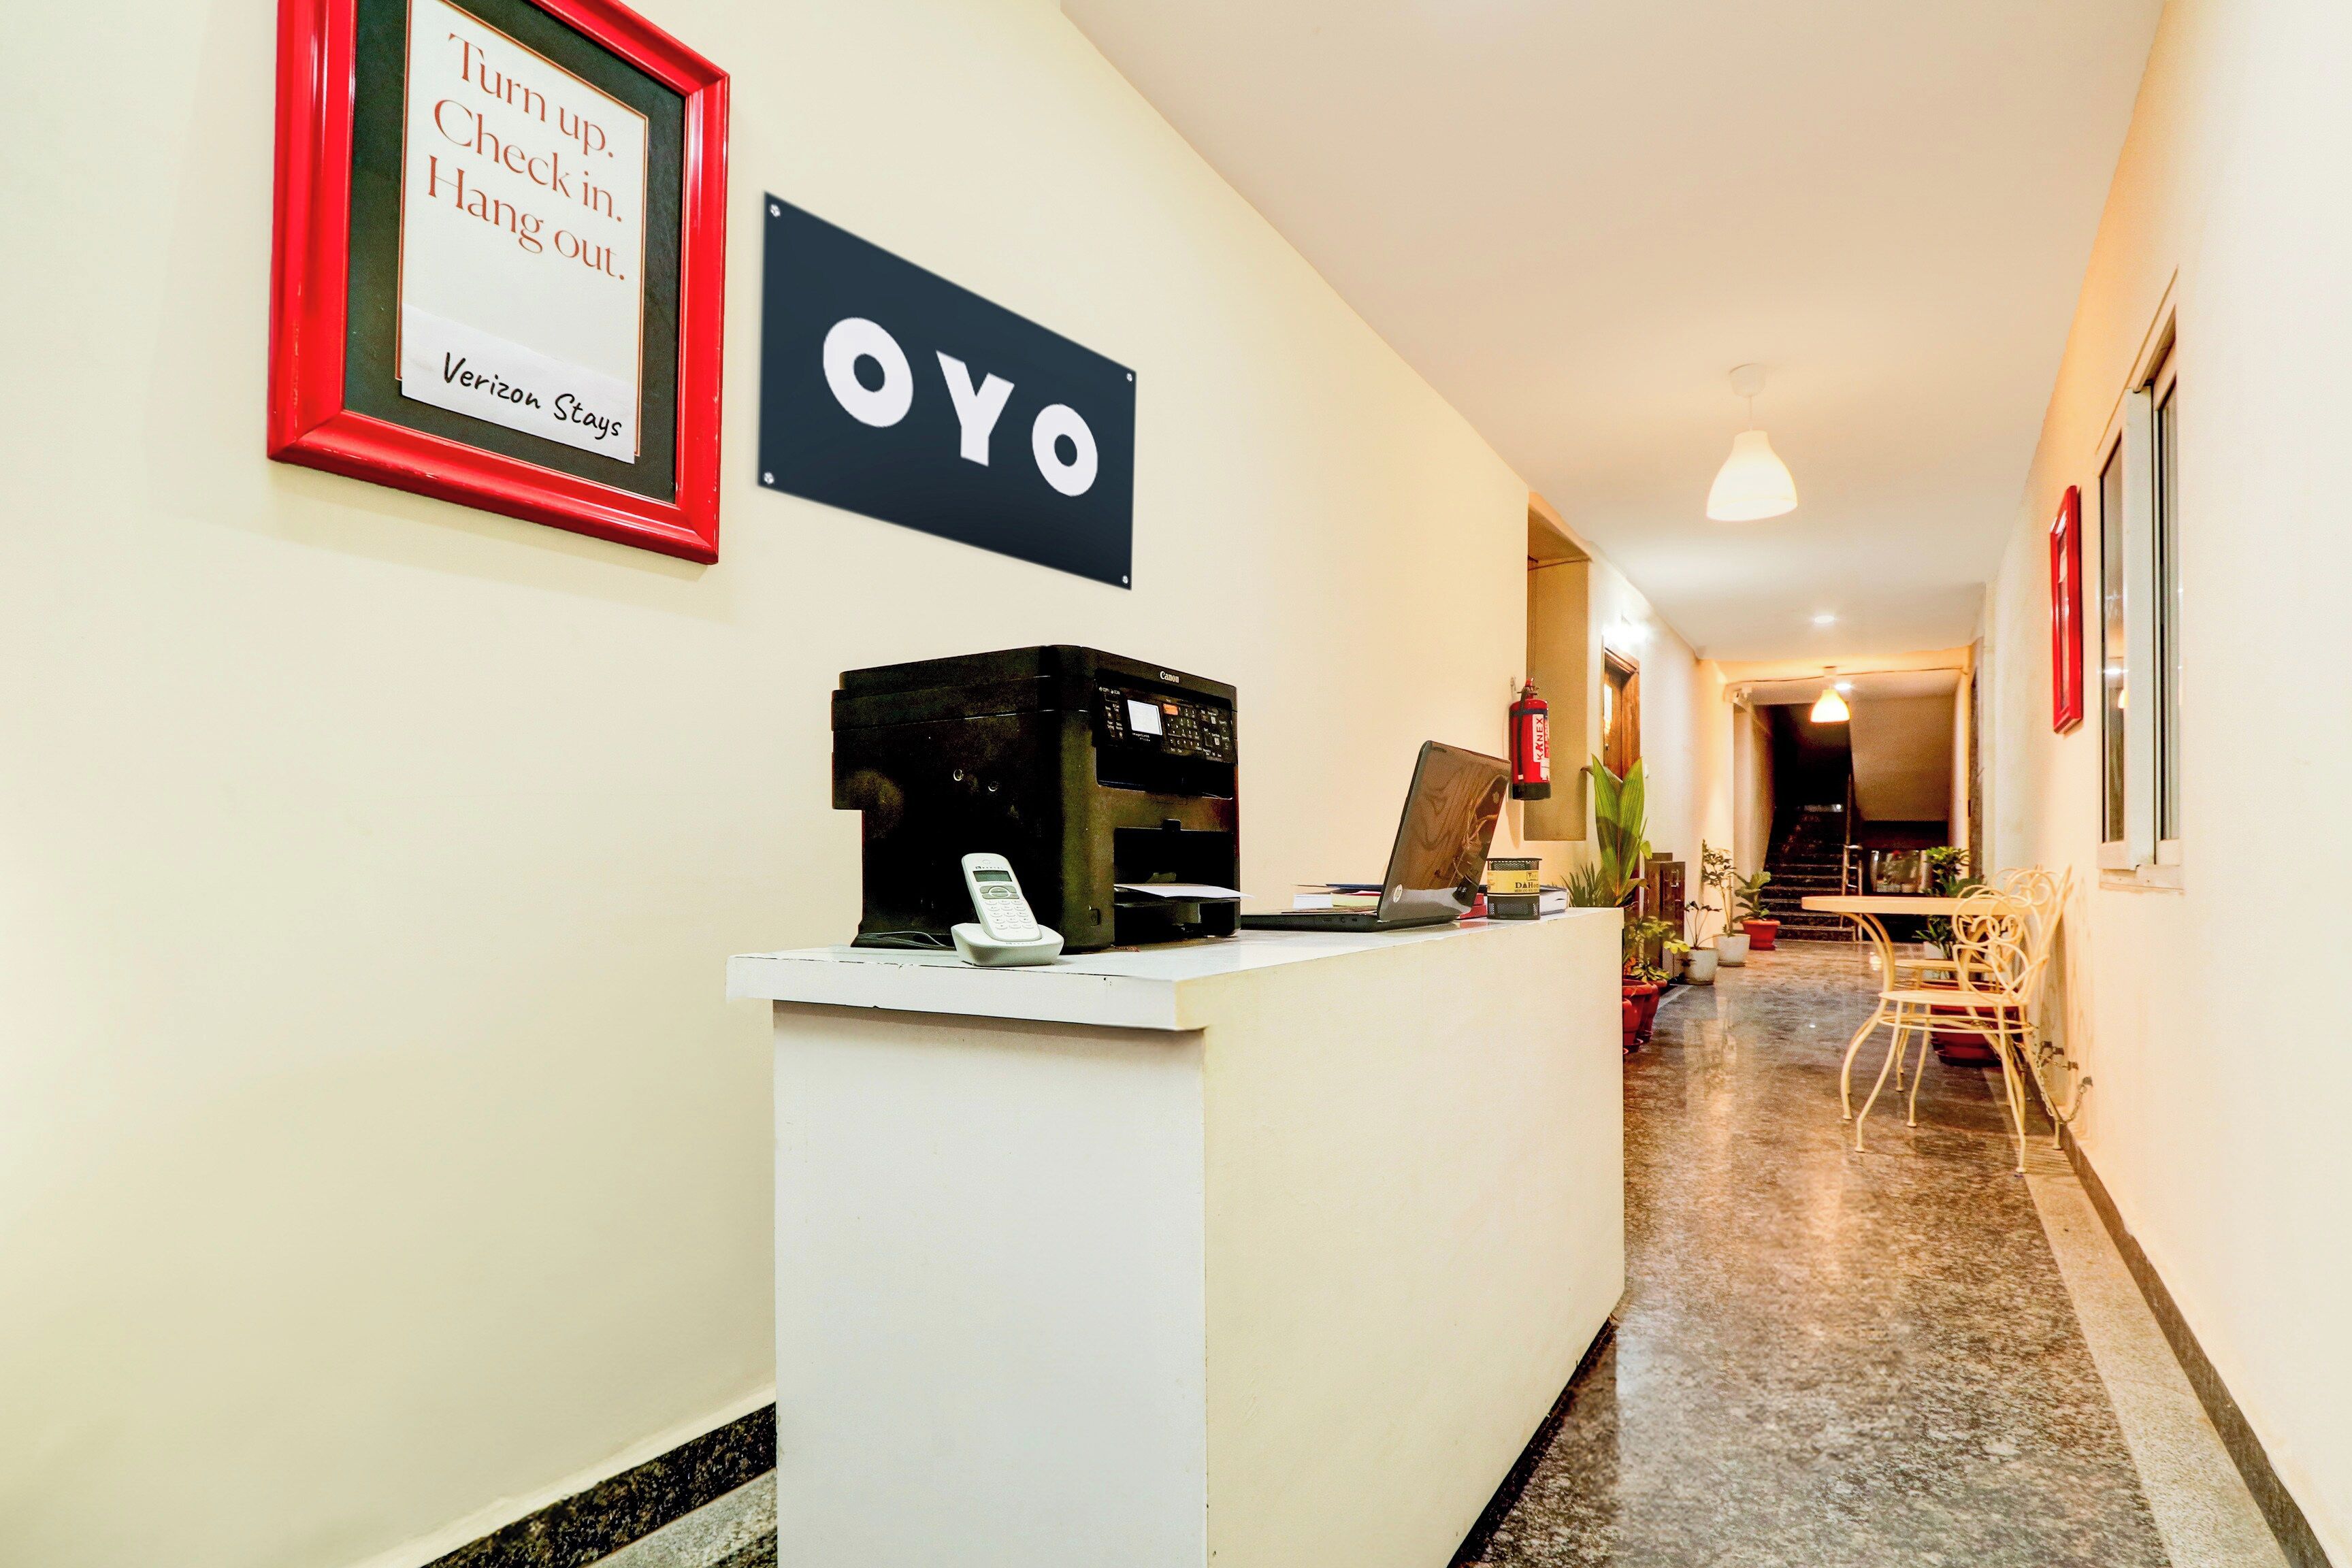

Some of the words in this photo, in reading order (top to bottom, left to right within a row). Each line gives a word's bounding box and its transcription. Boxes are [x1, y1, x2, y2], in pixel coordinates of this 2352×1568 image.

[448, 33, 546, 122] Turn
[558, 107, 614, 158] up.
[427, 155, 544, 254] Hang
[553, 229, 625, 281] out.
[433, 99, 572, 198] Check
[582, 171, 623, 223] in.
[444, 352, 541, 410] Verizon
[553, 393, 622, 440] Stays
[823, 317, 1098, 497] OYO
[1160, 670, 1179, 683] Canon
